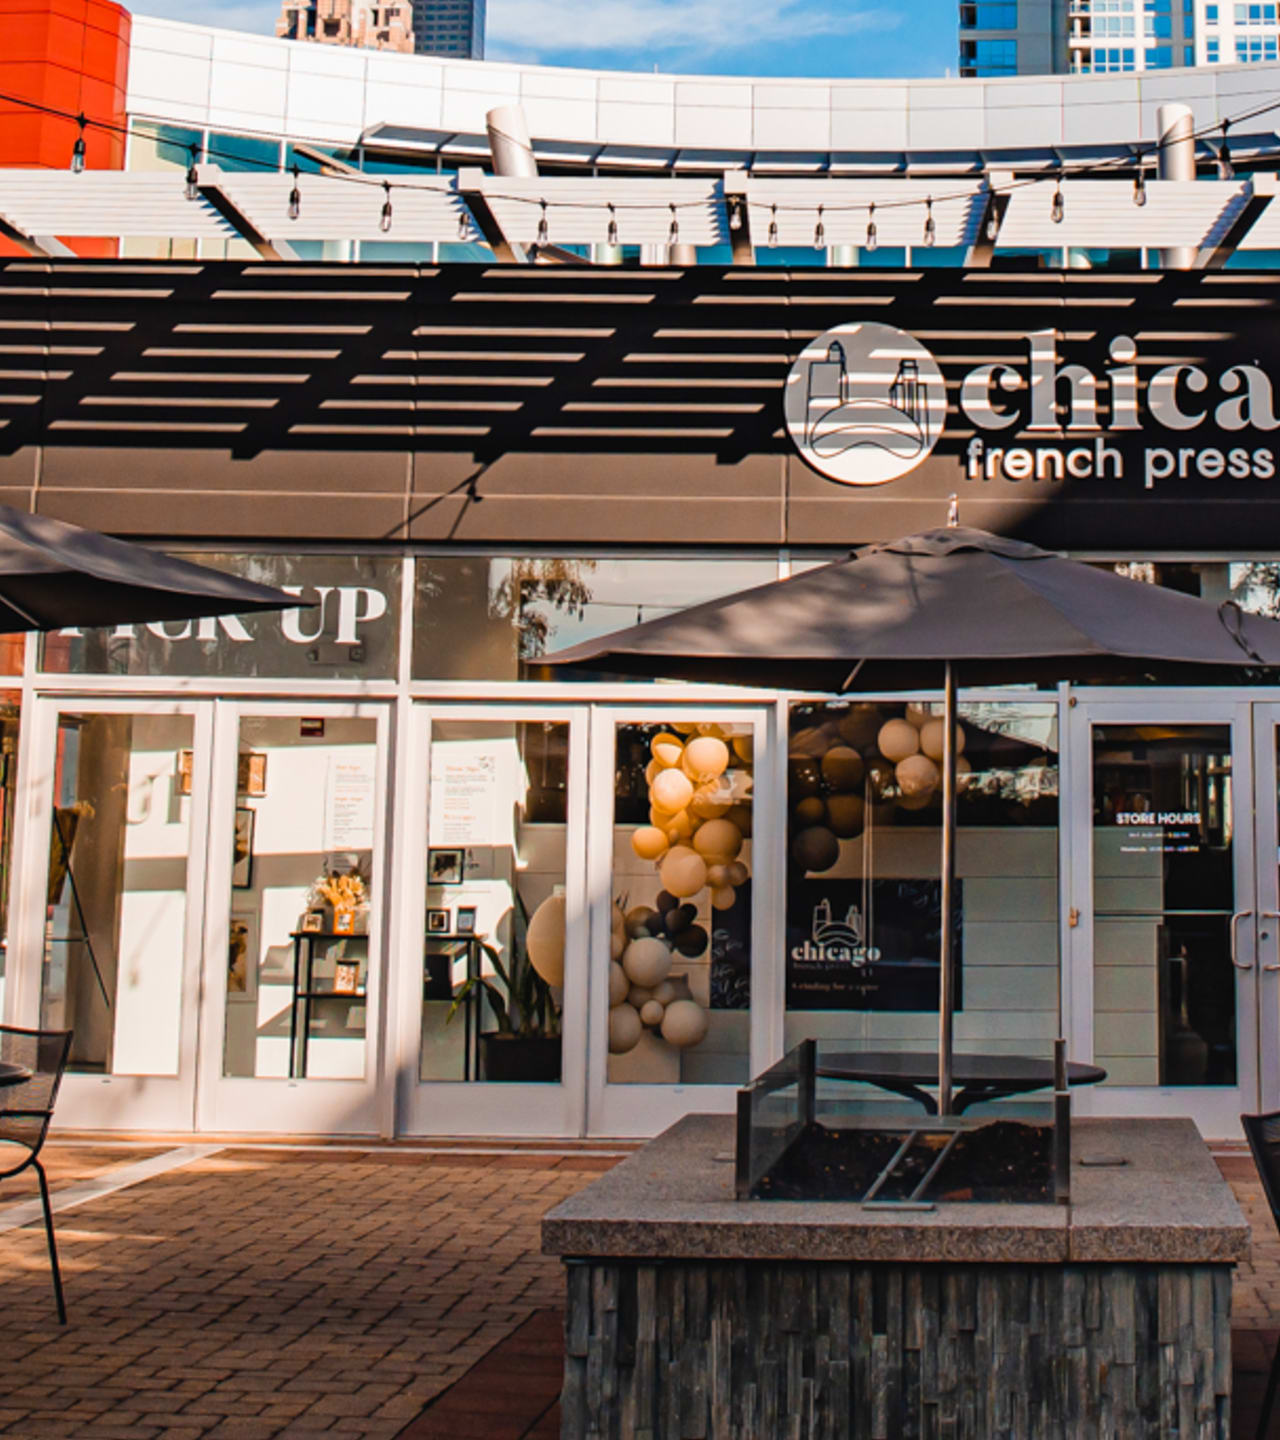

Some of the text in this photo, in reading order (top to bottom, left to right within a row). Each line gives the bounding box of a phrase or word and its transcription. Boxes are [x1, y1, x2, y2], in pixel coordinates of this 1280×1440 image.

[966, 437, 1276, 489] french press
[281, 586, 387, 644] UP
[1116, 812, 1201, 824] STORE HOURS
[791, 940, 881, 968] chicago
